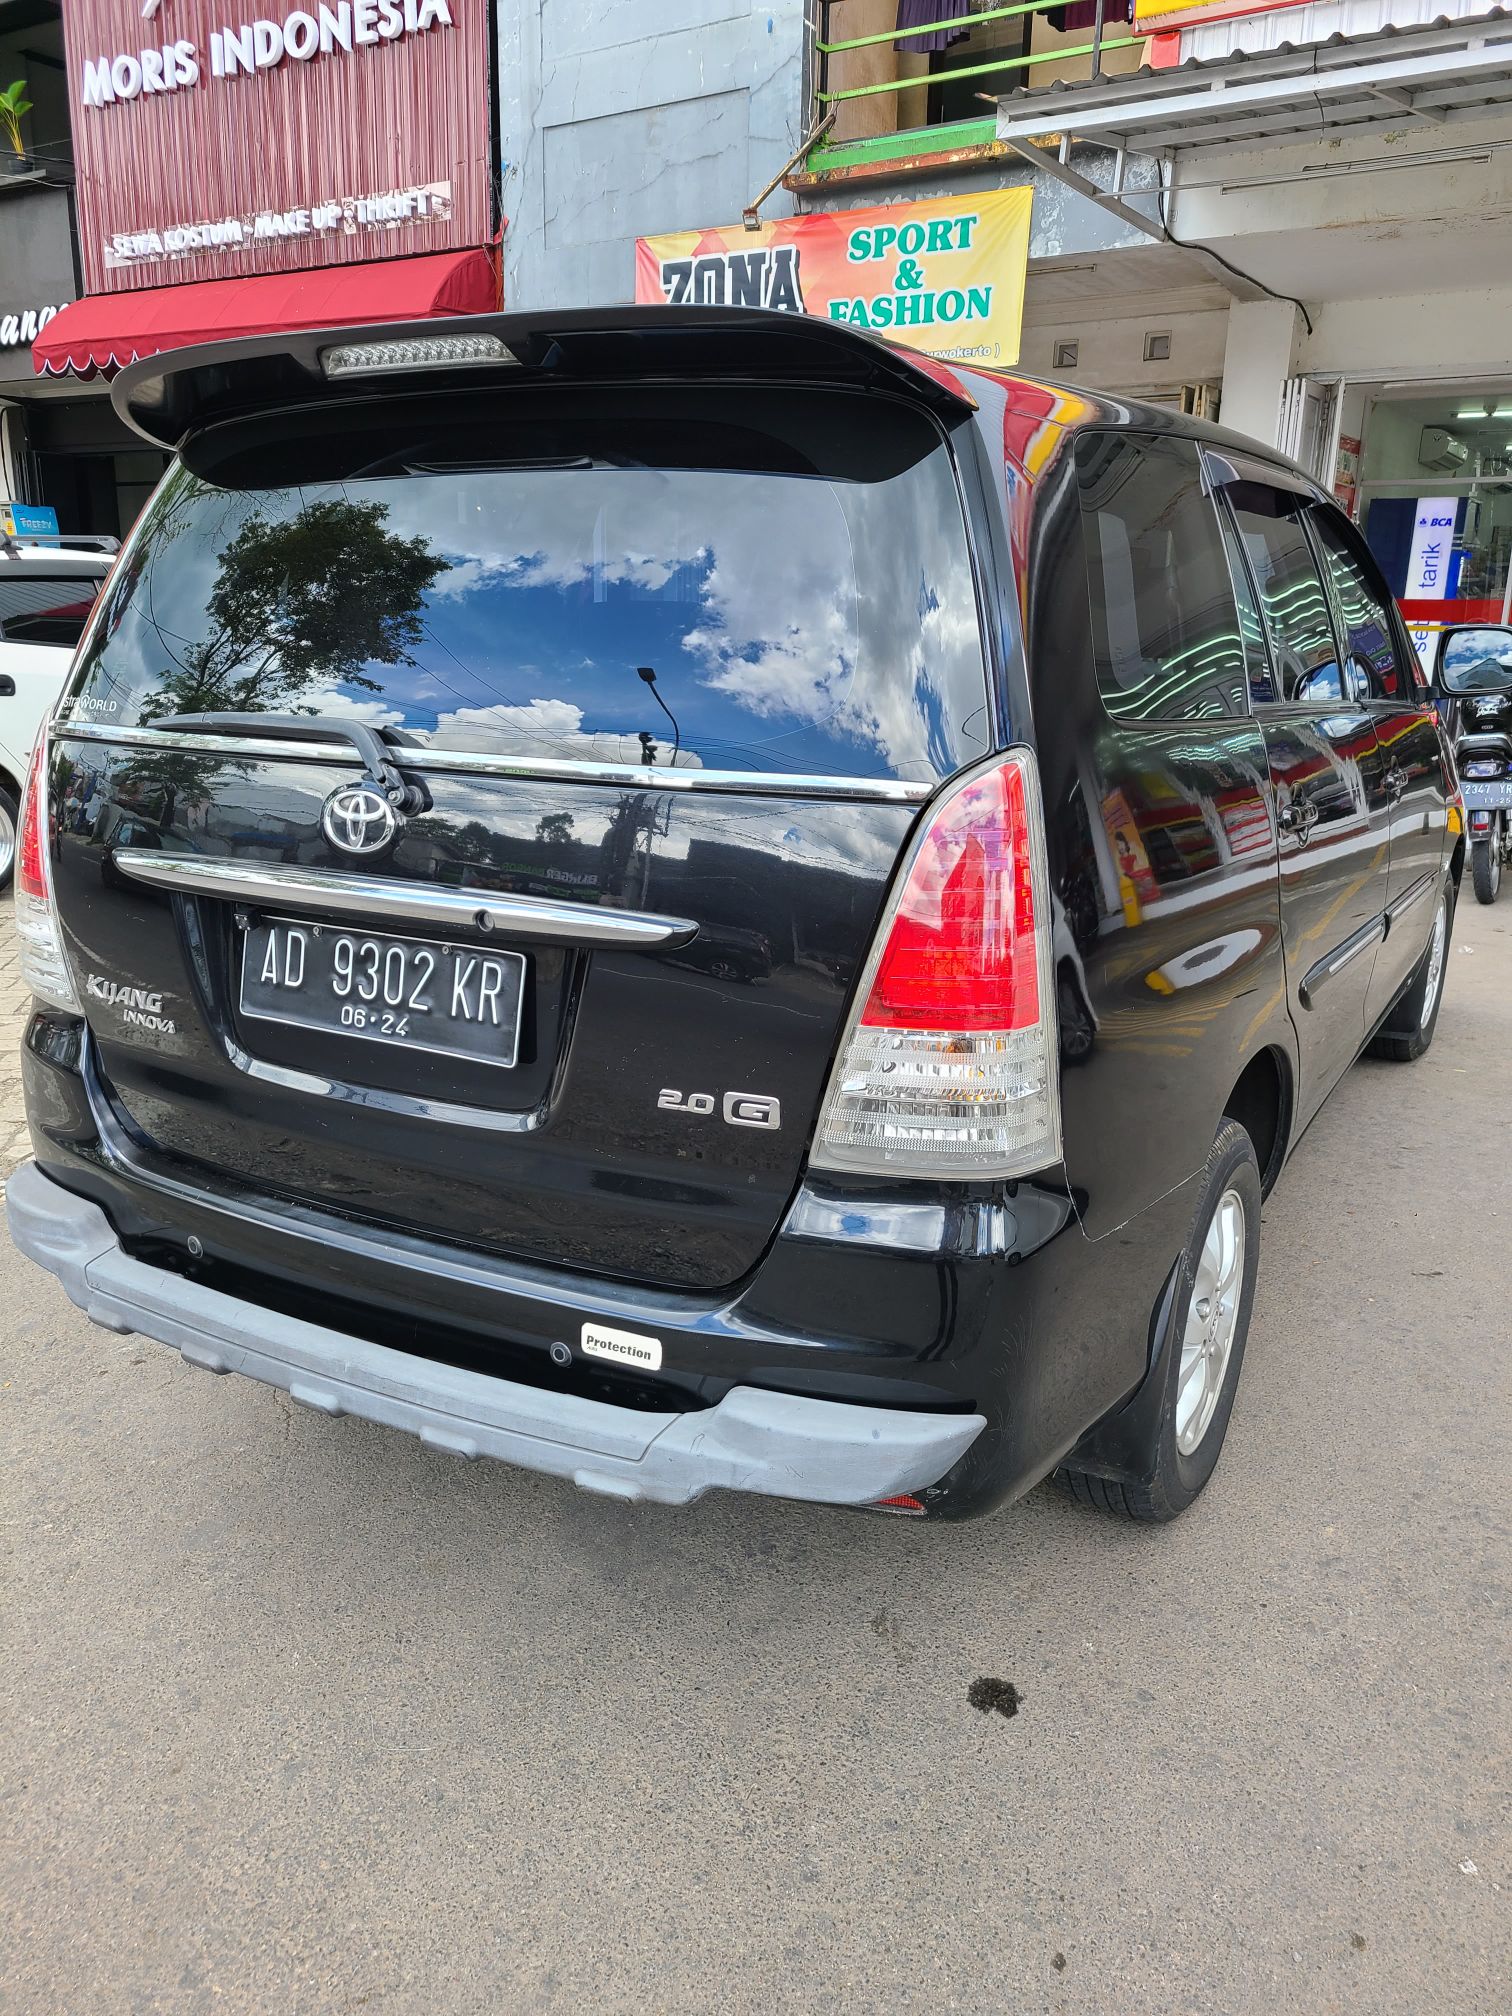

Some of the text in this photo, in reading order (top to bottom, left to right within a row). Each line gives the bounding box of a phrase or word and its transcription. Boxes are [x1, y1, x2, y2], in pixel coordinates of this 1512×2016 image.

[82, 0, 454, 108] MORIS INDONESIA
[254, 209, 311, 238] MAKE
[312, 203, 343, 230] UP
[354, 190, 432, 224] THRIFT
[848, 216, 979, 262] SPORT
[660, 248, 800, 314] ZONA
[894, 257, 925, 291] &
[828, 286, 993, 330] FASHION
[1430, 517, 1453, 528] BCA
[1418, 542, 1441, 590] tarik
[1465, 784, 1490, 796] 2347
[260, 928, 502, 1025] AD 9302 KR
[123, 1009, 176, 1034] INNOVA
[657, 1088, 778, 1129] 2.0 G
[586, 1335, 652, 1361] Protection
